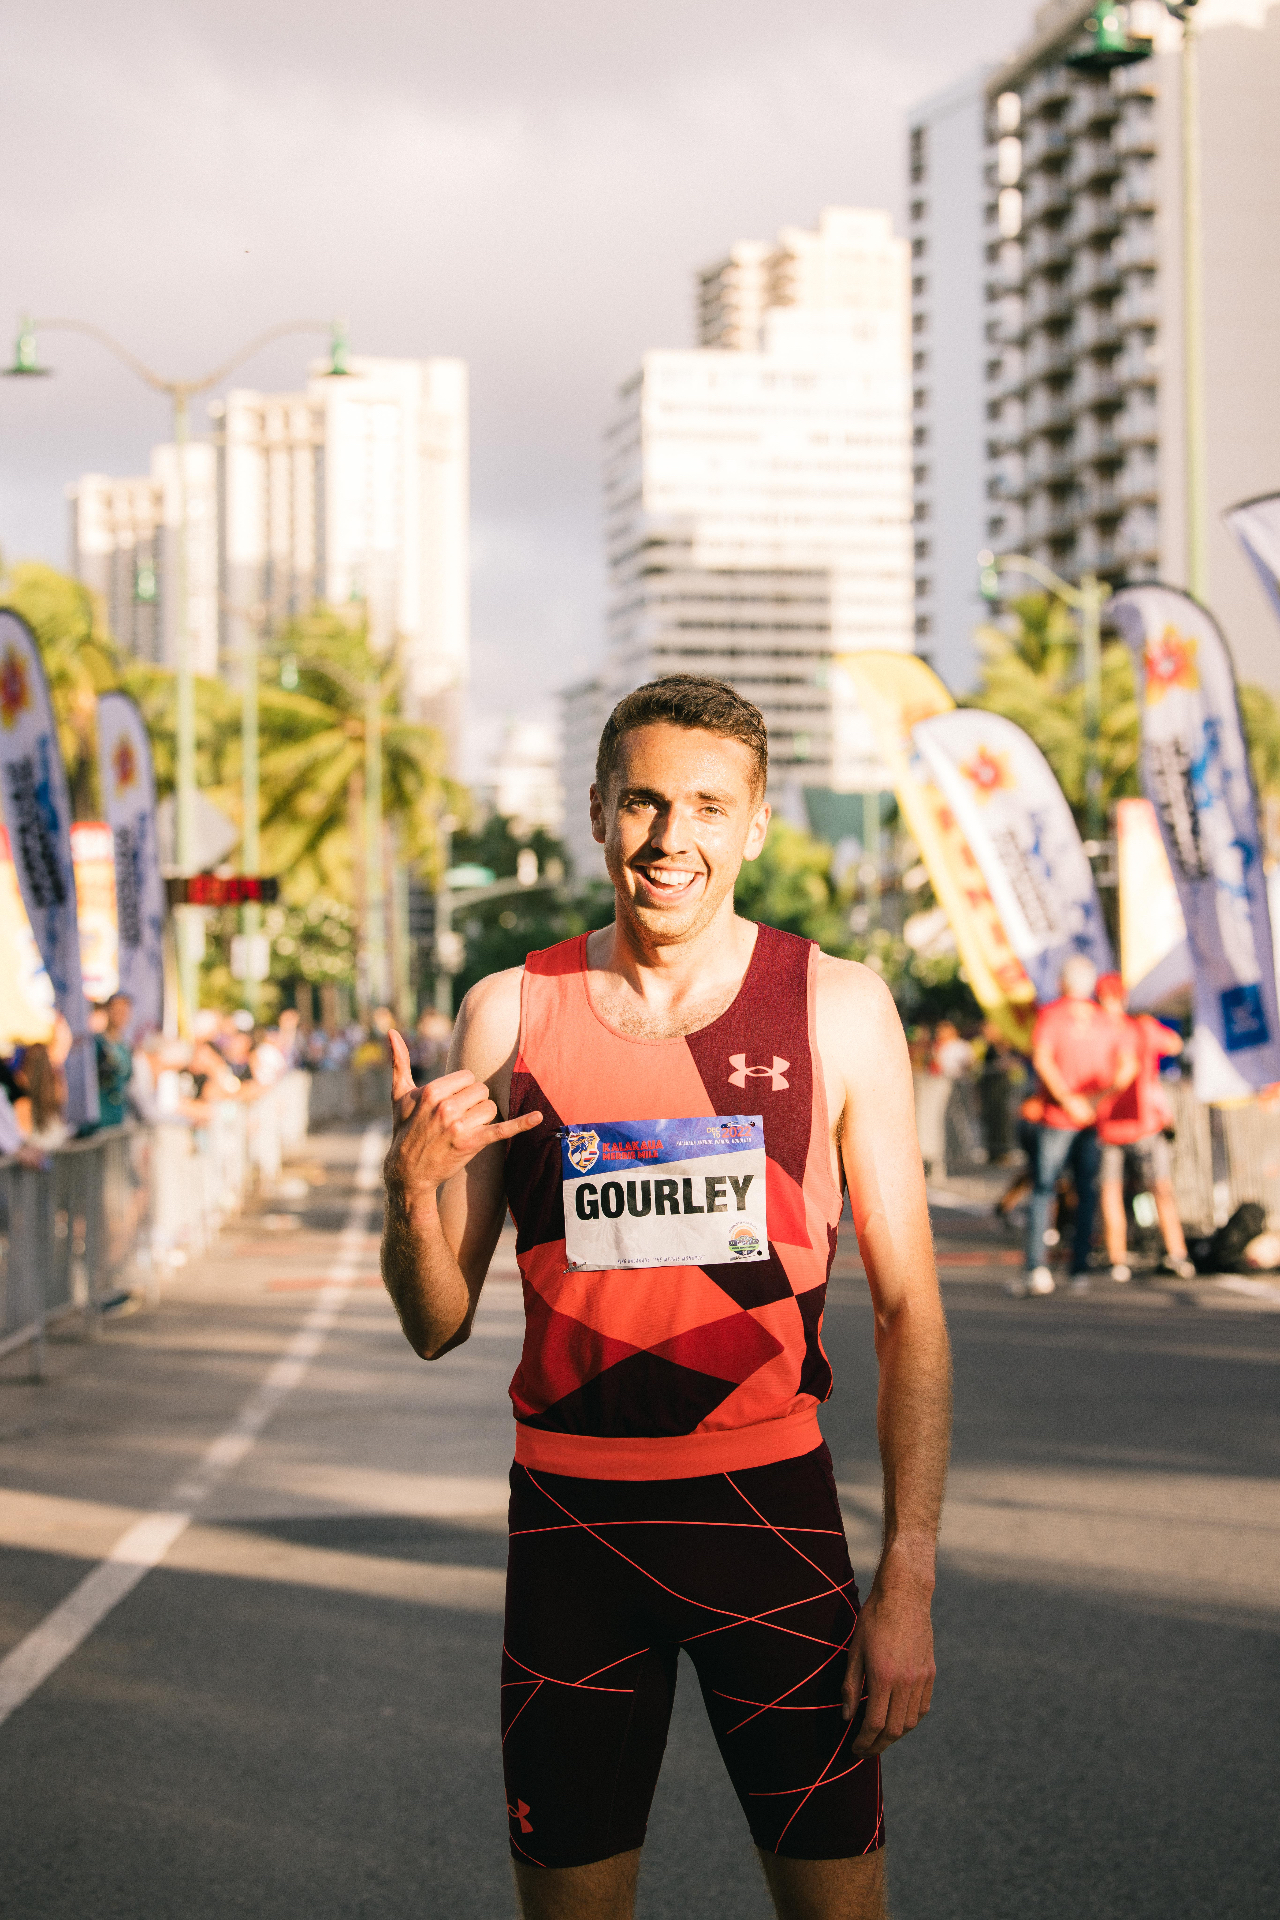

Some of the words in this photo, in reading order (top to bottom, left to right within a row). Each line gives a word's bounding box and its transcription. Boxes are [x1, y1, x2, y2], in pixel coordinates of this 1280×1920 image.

[721, 1126, 752, 1138] 2022
[602, 1140, 664, 1152] KALAKAUA
[602, 1151, 636, 1161] MERRIE
[637, 1150, 658, 1159] MILE
[575, 1174, 755, 1220] GOURLEY
